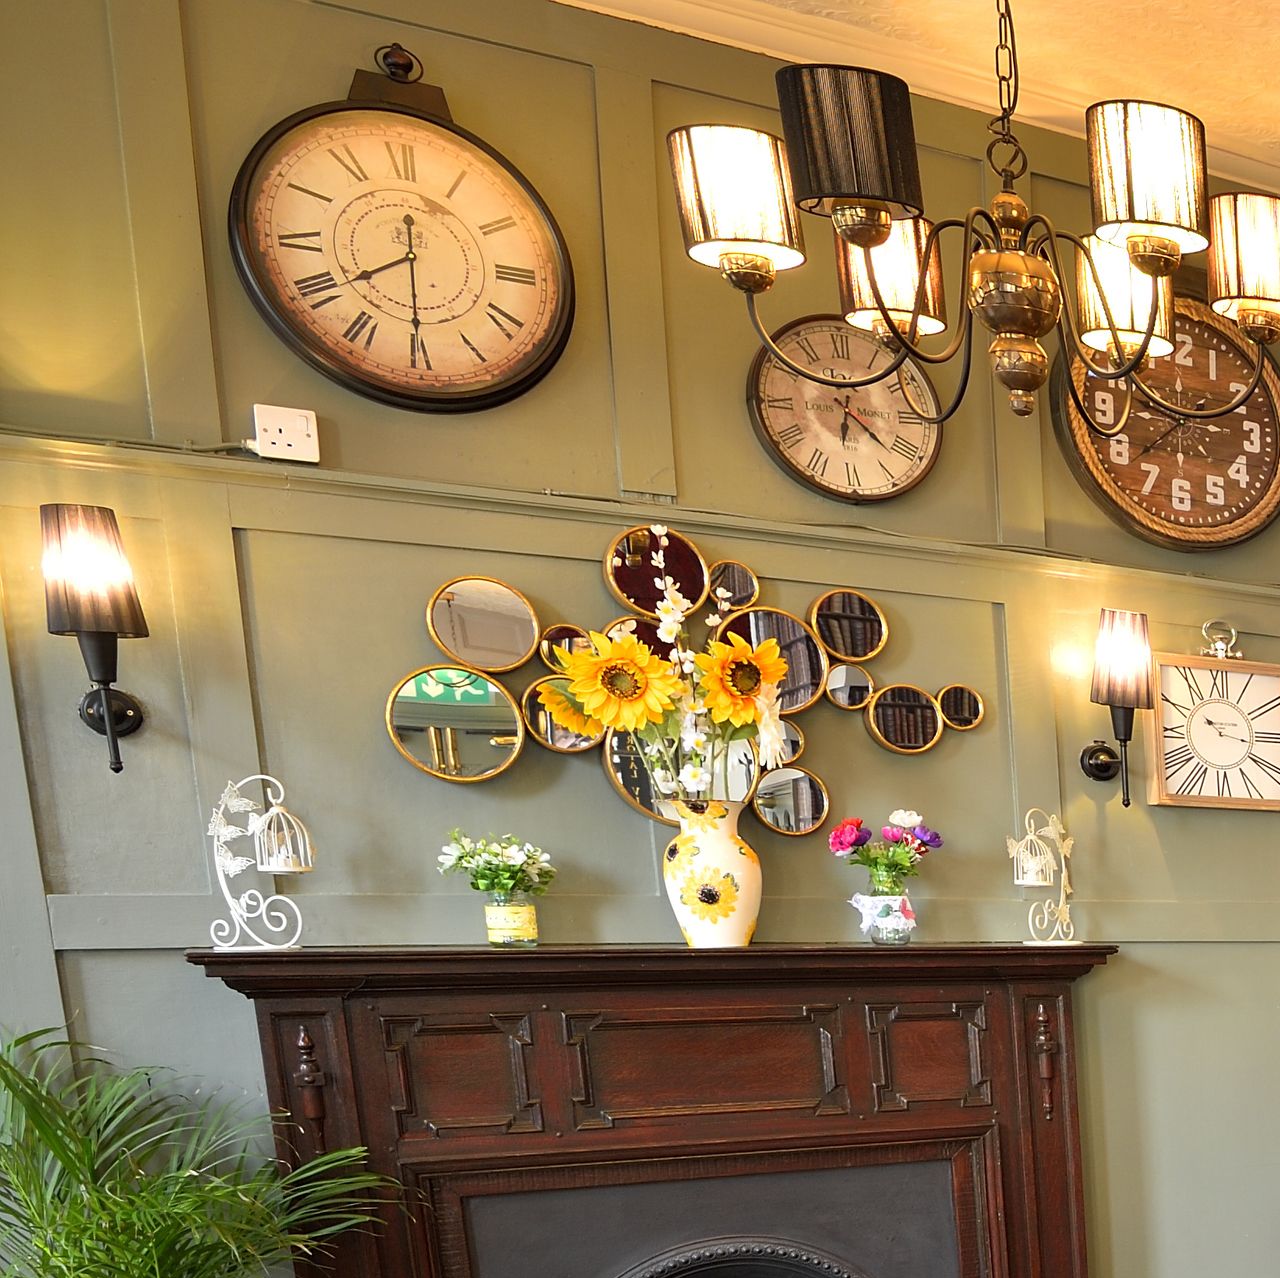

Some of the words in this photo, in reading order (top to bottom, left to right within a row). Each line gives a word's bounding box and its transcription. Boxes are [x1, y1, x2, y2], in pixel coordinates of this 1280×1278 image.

[830, 333, 851, 360] XII
[1208, 350, 1217, 381] 1
[805, 401, 834, 413] LOUIS
[857, 407, 892, 420] MONET
[1095, 391, 1114, 425] 9
[1110, 433, 1129, 465] 8
[1243, 421, 1261, 453] 3
[1140, 463, 1160, 495] 7
[1227, 455, 1250, 488] 4
[1171, 478, 1191, 511] 6
[1206, 475, 1225, 505] 5
[1209, 669, 1229, 700] XII
